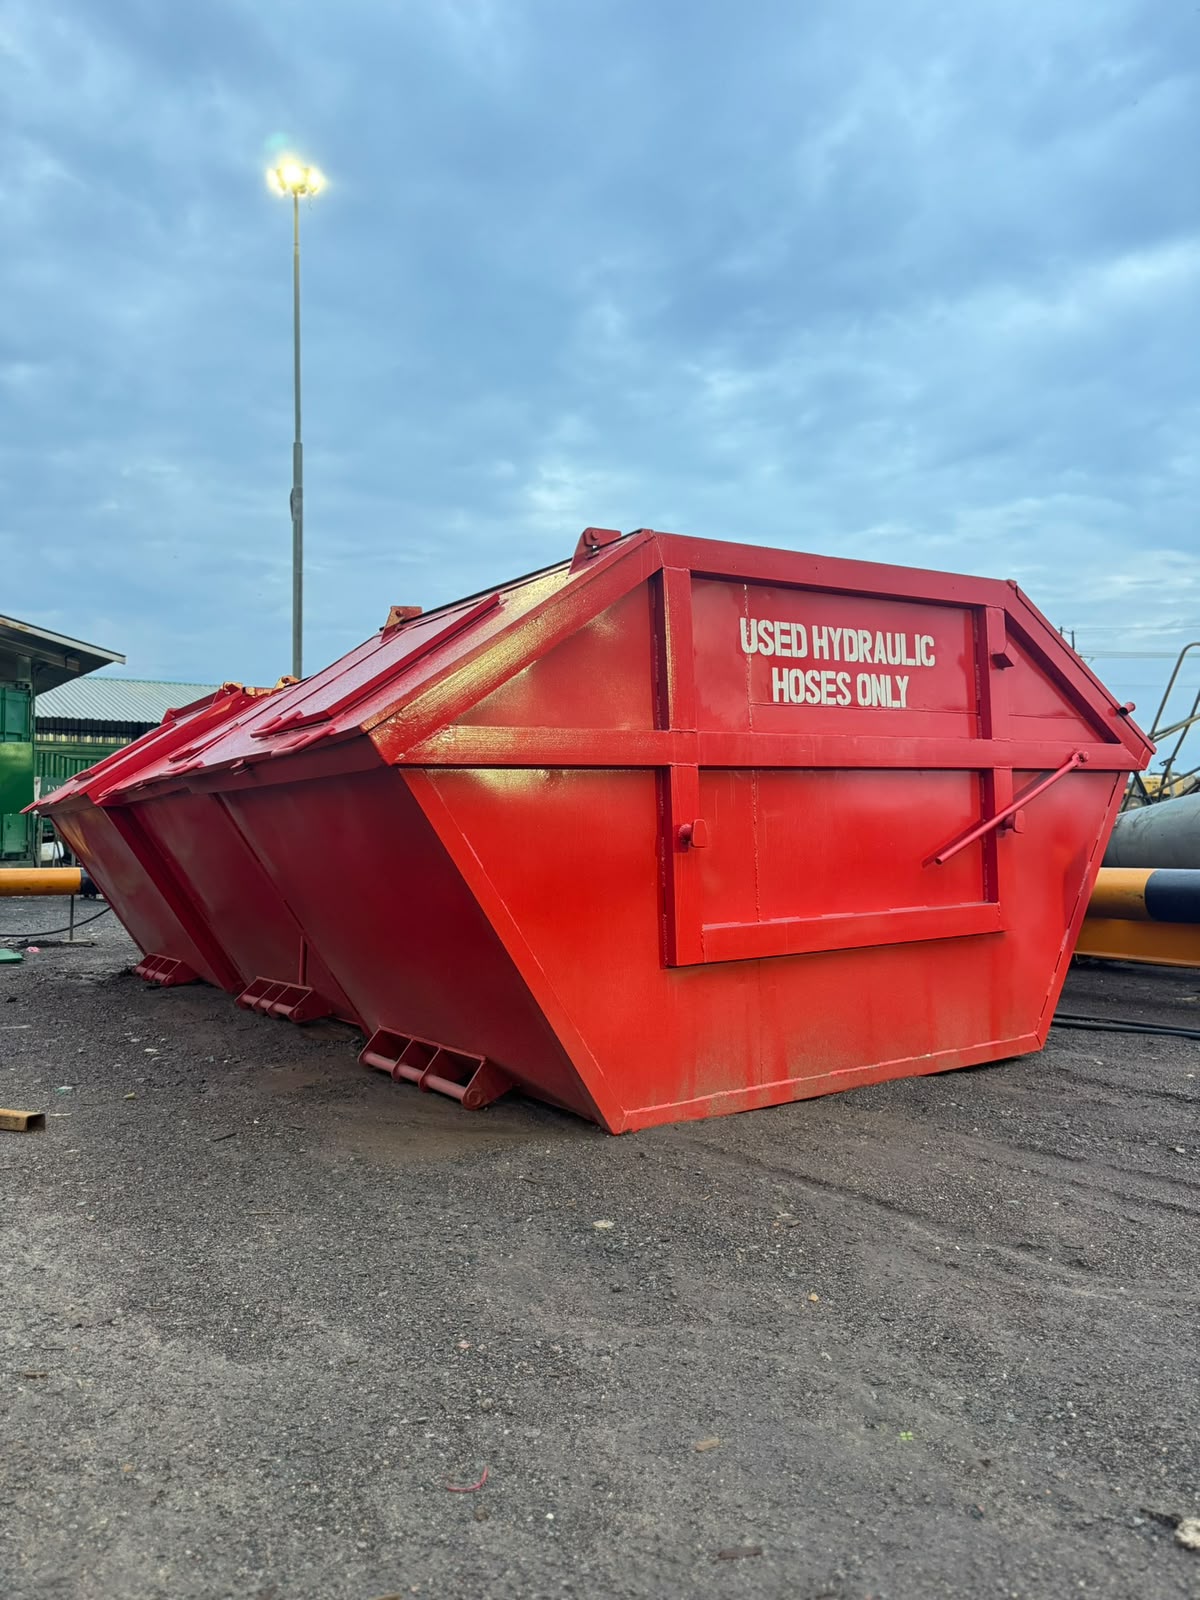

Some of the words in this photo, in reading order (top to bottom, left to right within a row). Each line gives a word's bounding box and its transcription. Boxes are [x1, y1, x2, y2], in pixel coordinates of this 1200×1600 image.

[740, 617, 807, 657] USED
[812, 625, 935, 666] HYDRAULIC
[772, 667, 851, 705] HOSES
[857, 673, 909, 708] ONLY
